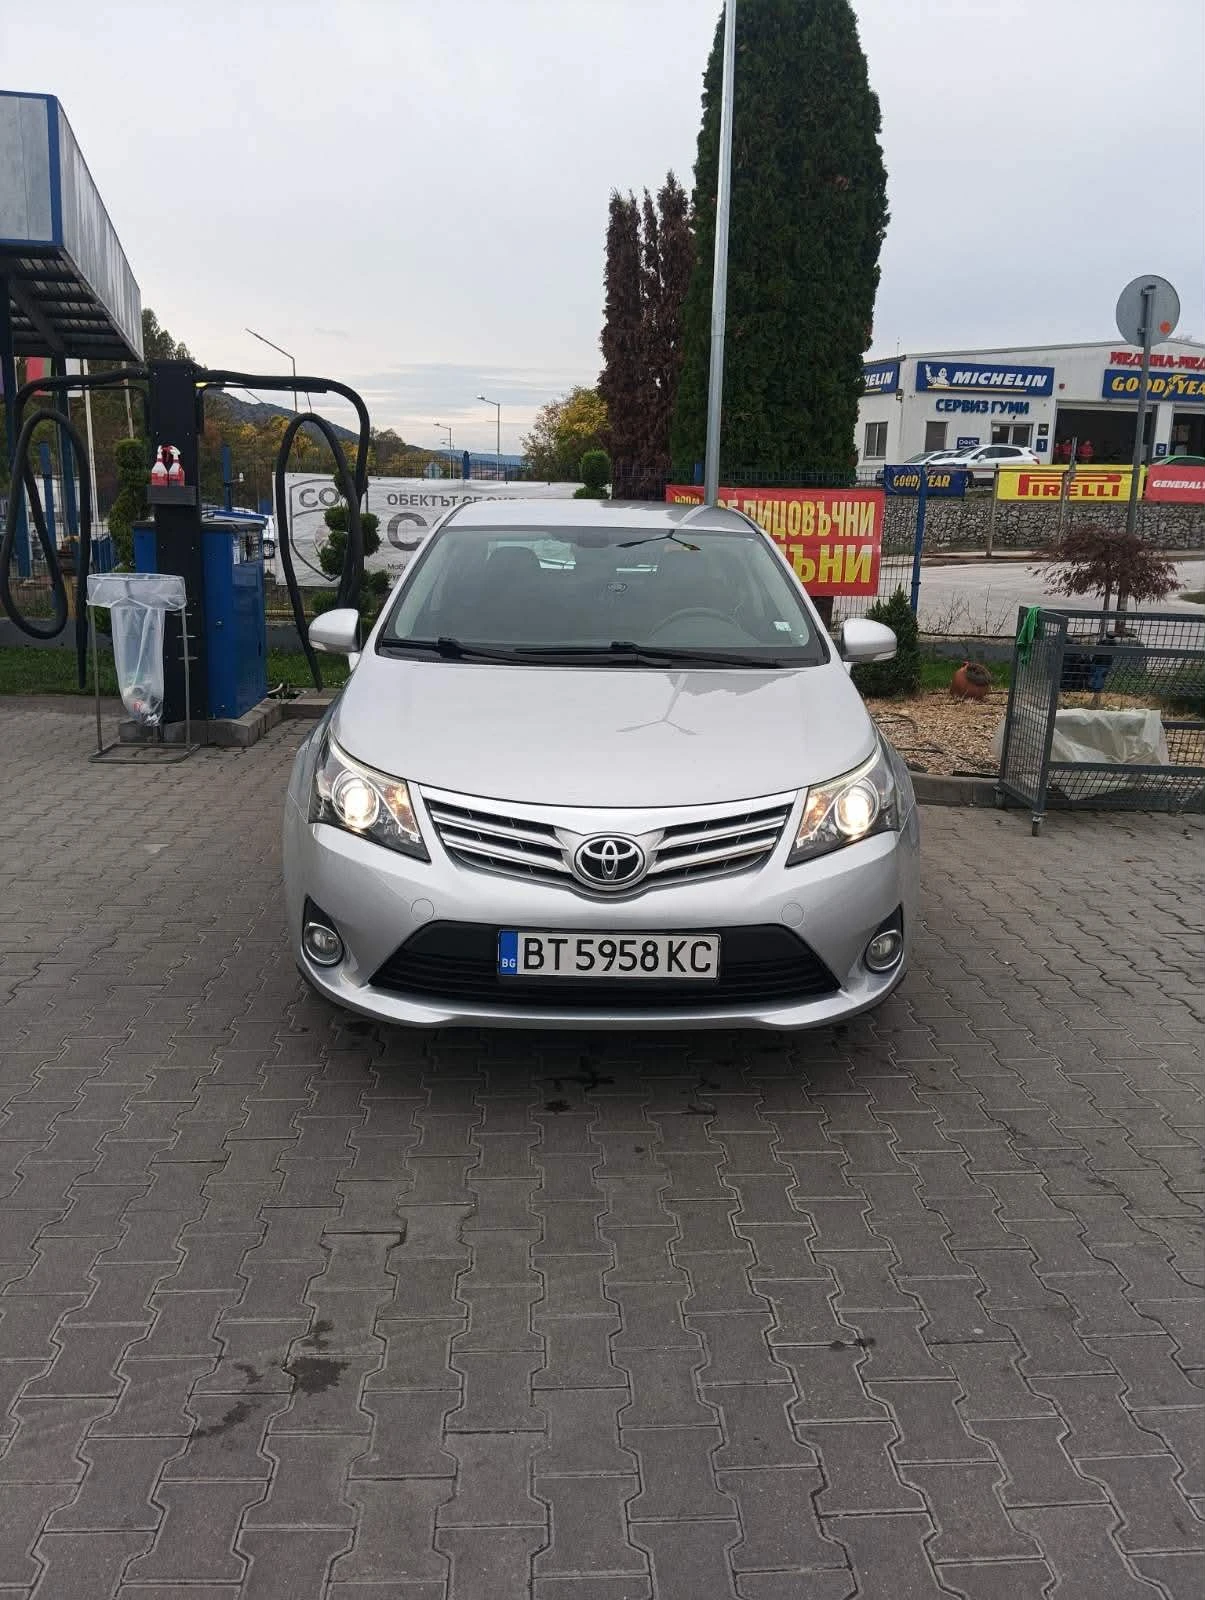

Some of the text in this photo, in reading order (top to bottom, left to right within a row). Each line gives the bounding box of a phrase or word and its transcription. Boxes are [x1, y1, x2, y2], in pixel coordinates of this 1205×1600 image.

[862, 371, 894, 387] HELIN
[952, 371, 1047, 387] MICHELIN
[935, 398, 1030, 415] СЕРВИЗ ГУМИ
[1158, 445, 1165, 454] 2
[893, 475, 951, 488] GOODEAR
[1018, 475, 1122, 496] PIRELLI
[299, 487, 341, 508] СО
[387, 493, 458, 507] ОБЕКТЪТ
[717, 499, 875, 540] ЛИЦОВЪЧНИ
[785, 544, 873, 583] ЪНИ
[501, 957, 516, 969] BG
[523, 937, 712, 973] BT 5958 KC
